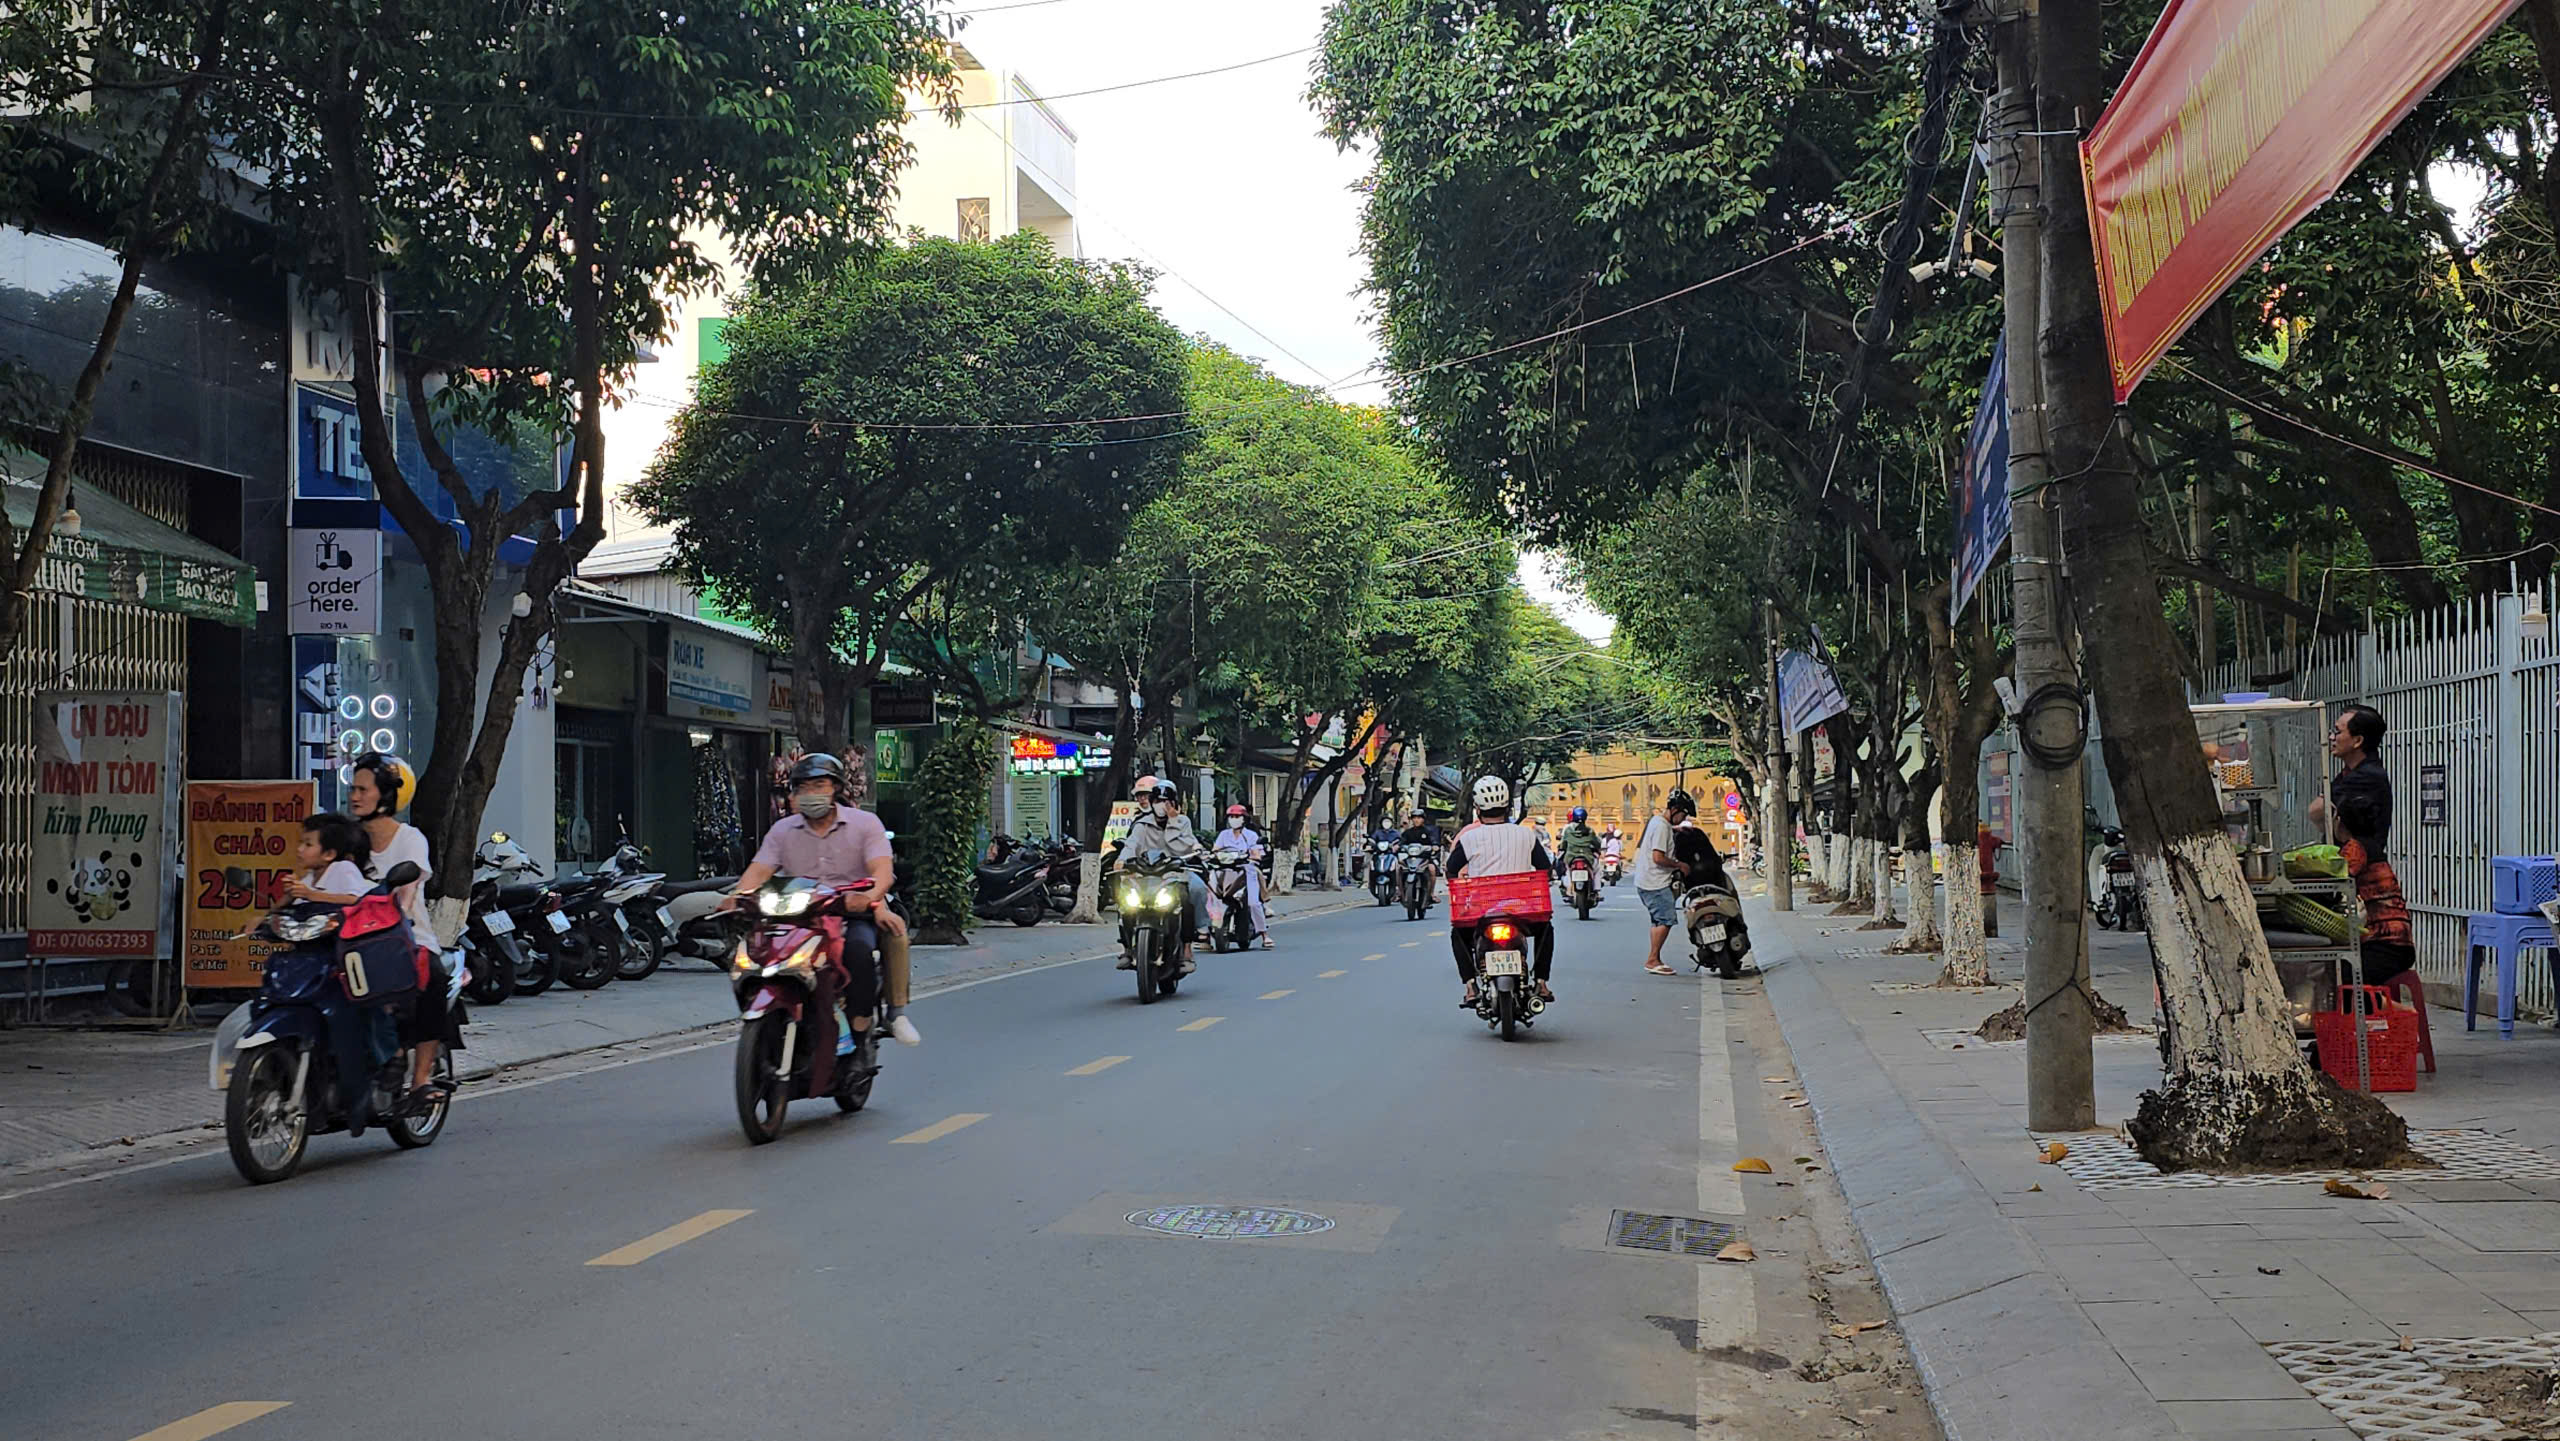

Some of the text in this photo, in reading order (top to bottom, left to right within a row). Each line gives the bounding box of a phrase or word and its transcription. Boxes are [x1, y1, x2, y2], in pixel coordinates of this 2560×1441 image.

[311, 404, 373, 482] TE
[64, 534, 99, 560] TÔM
[308, 577, 361, 594] order
[310, 595, 359, 613] here.
[335, 622, 348, 630] TEA
[693, 645, 705, 669] XE
[71, 697, 150, 745] ÚN ĐẬU
[106, 754, 156, 795] TÔM
[192, 793, 304, 823] BÁNH MÌ
[43, 805, 148, 843] Kim Phụng
[214, 828, 286, 856] CHẢO
[60, 933, 148, 949] 0706637393
